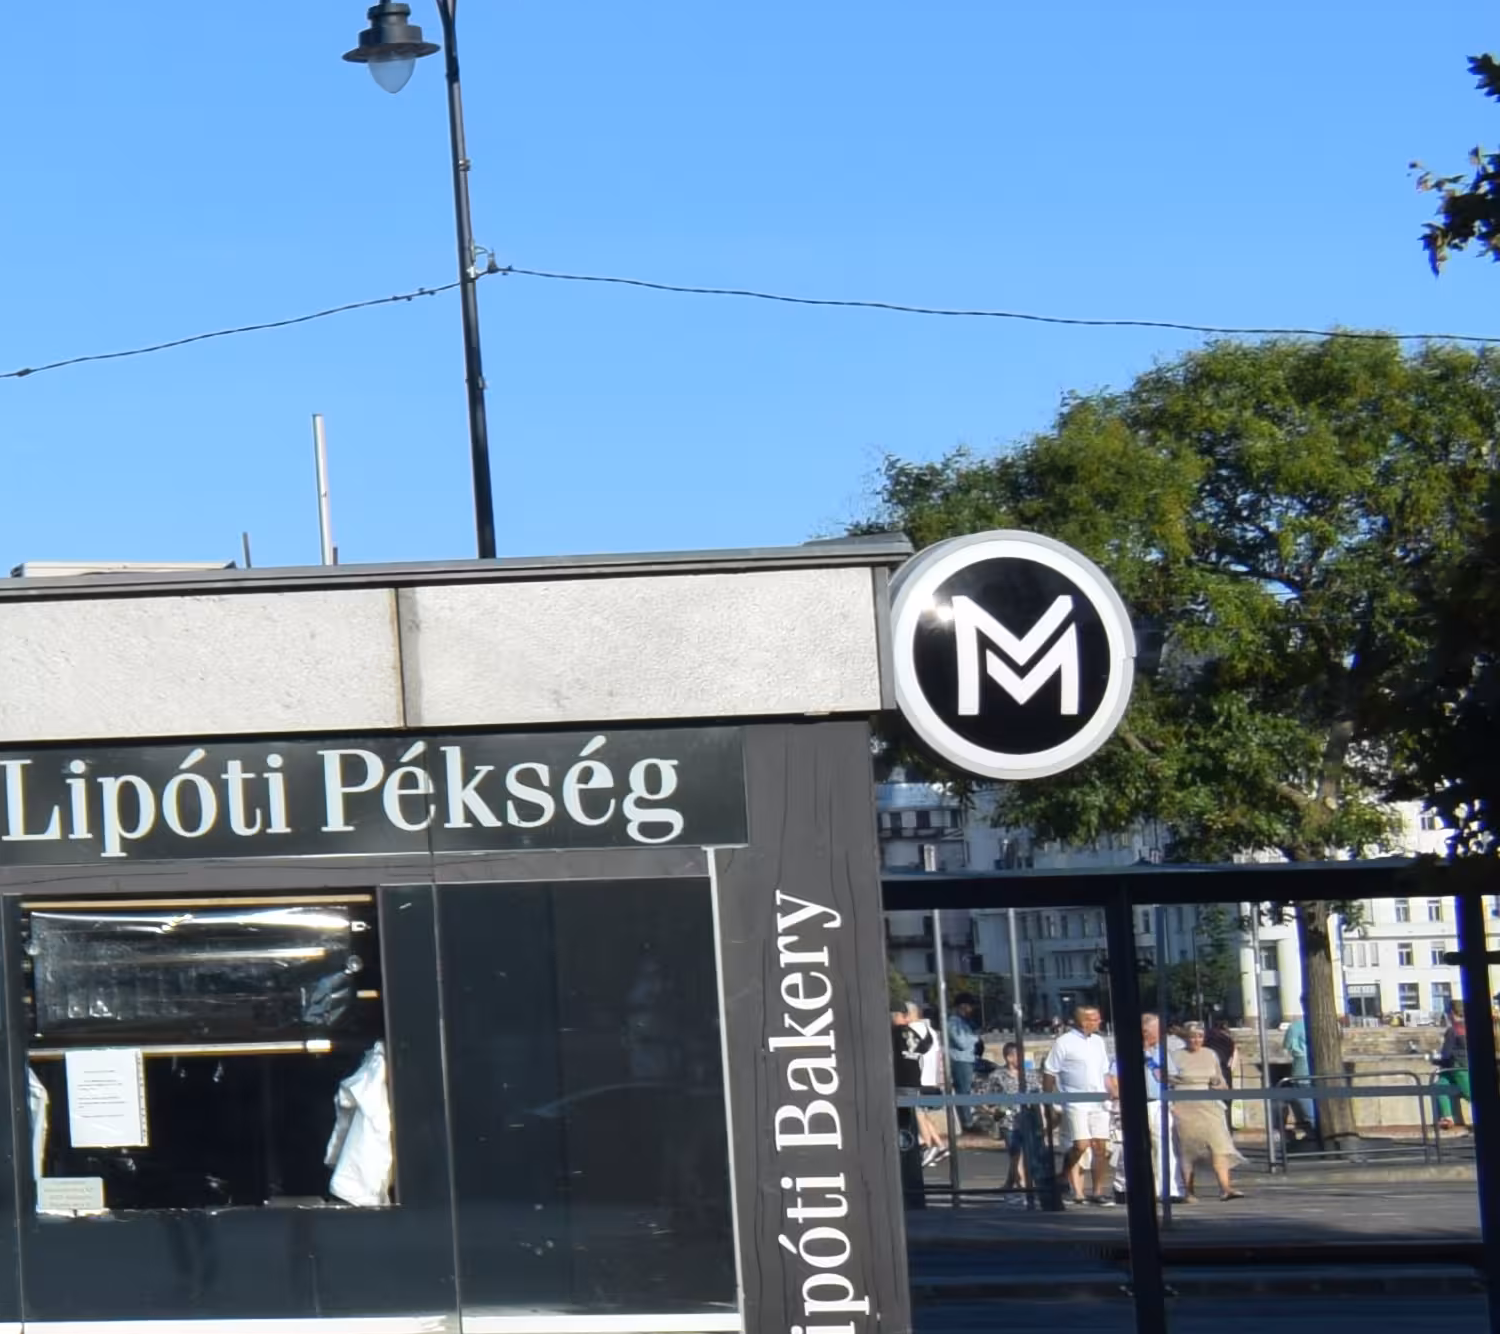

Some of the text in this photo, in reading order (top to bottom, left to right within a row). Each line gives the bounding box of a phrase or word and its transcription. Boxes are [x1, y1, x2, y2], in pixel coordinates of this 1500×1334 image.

[952, 594, 1080, 716] M
[316, 734, 685, 844] Pékség
[775, 889, 842, 1153] Bakery
